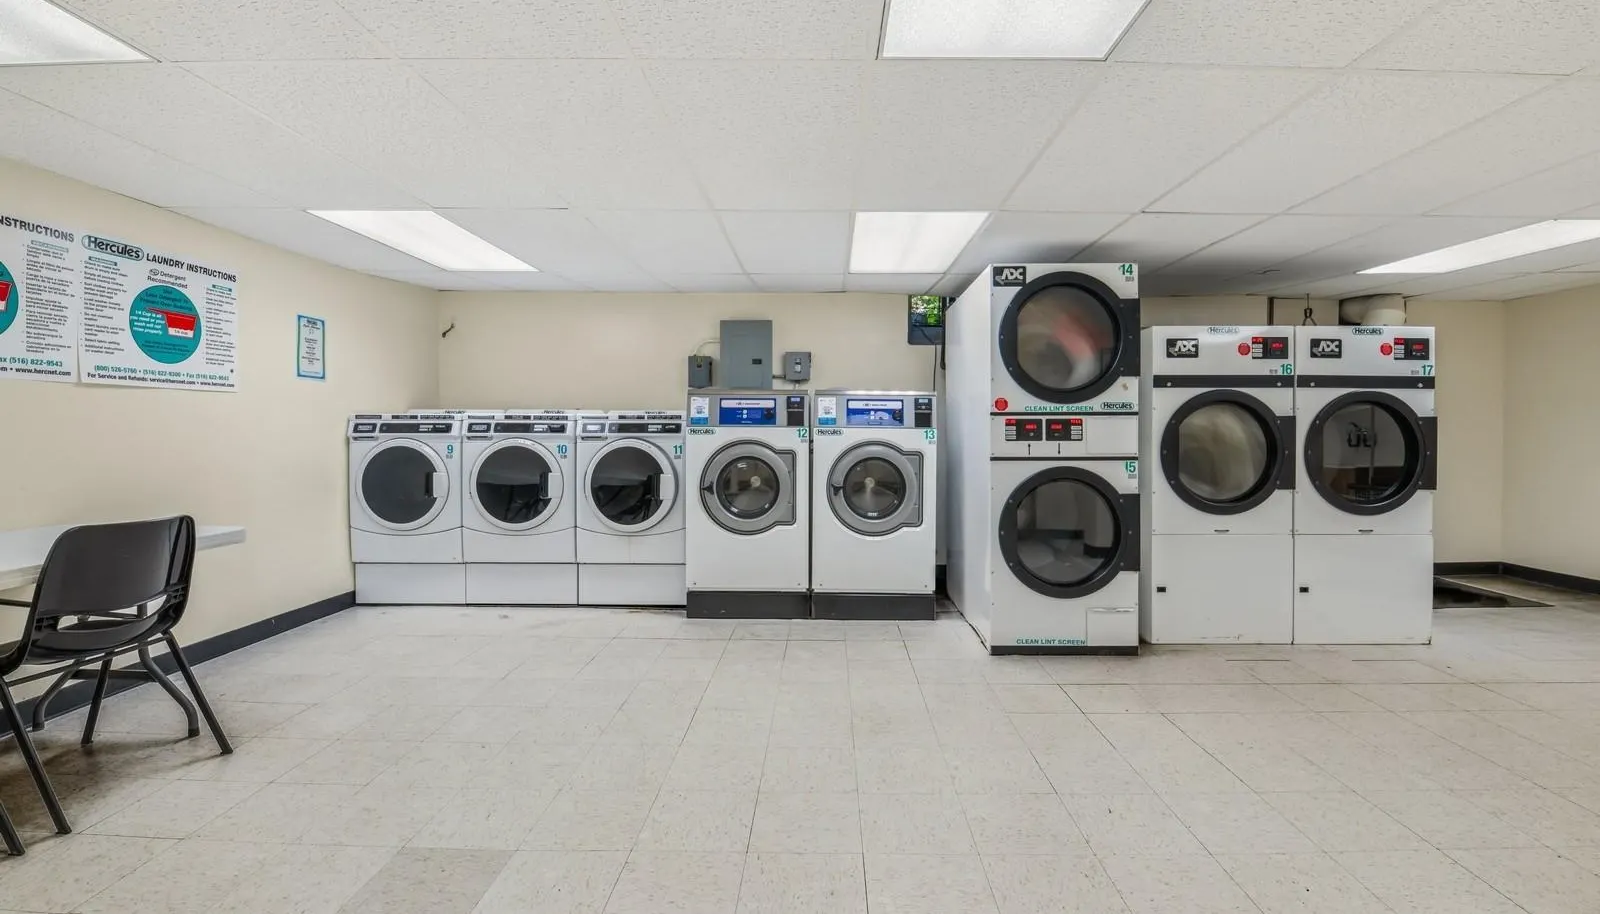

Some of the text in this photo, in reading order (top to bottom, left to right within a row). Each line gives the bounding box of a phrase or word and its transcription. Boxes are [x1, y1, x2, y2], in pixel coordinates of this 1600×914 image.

[88, 236, 140, 258] Hercules
[146, 253, 185, 269] LAUNDRY
[186, 263, 237, 282] INSTRUCTIONS
[1120, 264, 1134, 276] 14
[160, 270, 186, 282] Detergent
[147, 275, 188, 289] Recommended
[9, 357, 28, 366] (516)
[15, 367, 71, 376] www.hercnet.com
[94, 364, 110, 373] (800)
[1280, 364, 1293, 375] 16
[1422, 364, 1434, 375] 17
[796, 428, 808, 438] 12
[924, 429, 936, 440] 13
[447, 444, 453, 454] 9
[557, 444, 568, 454] 10
[673, 445, 683, 454] 11
